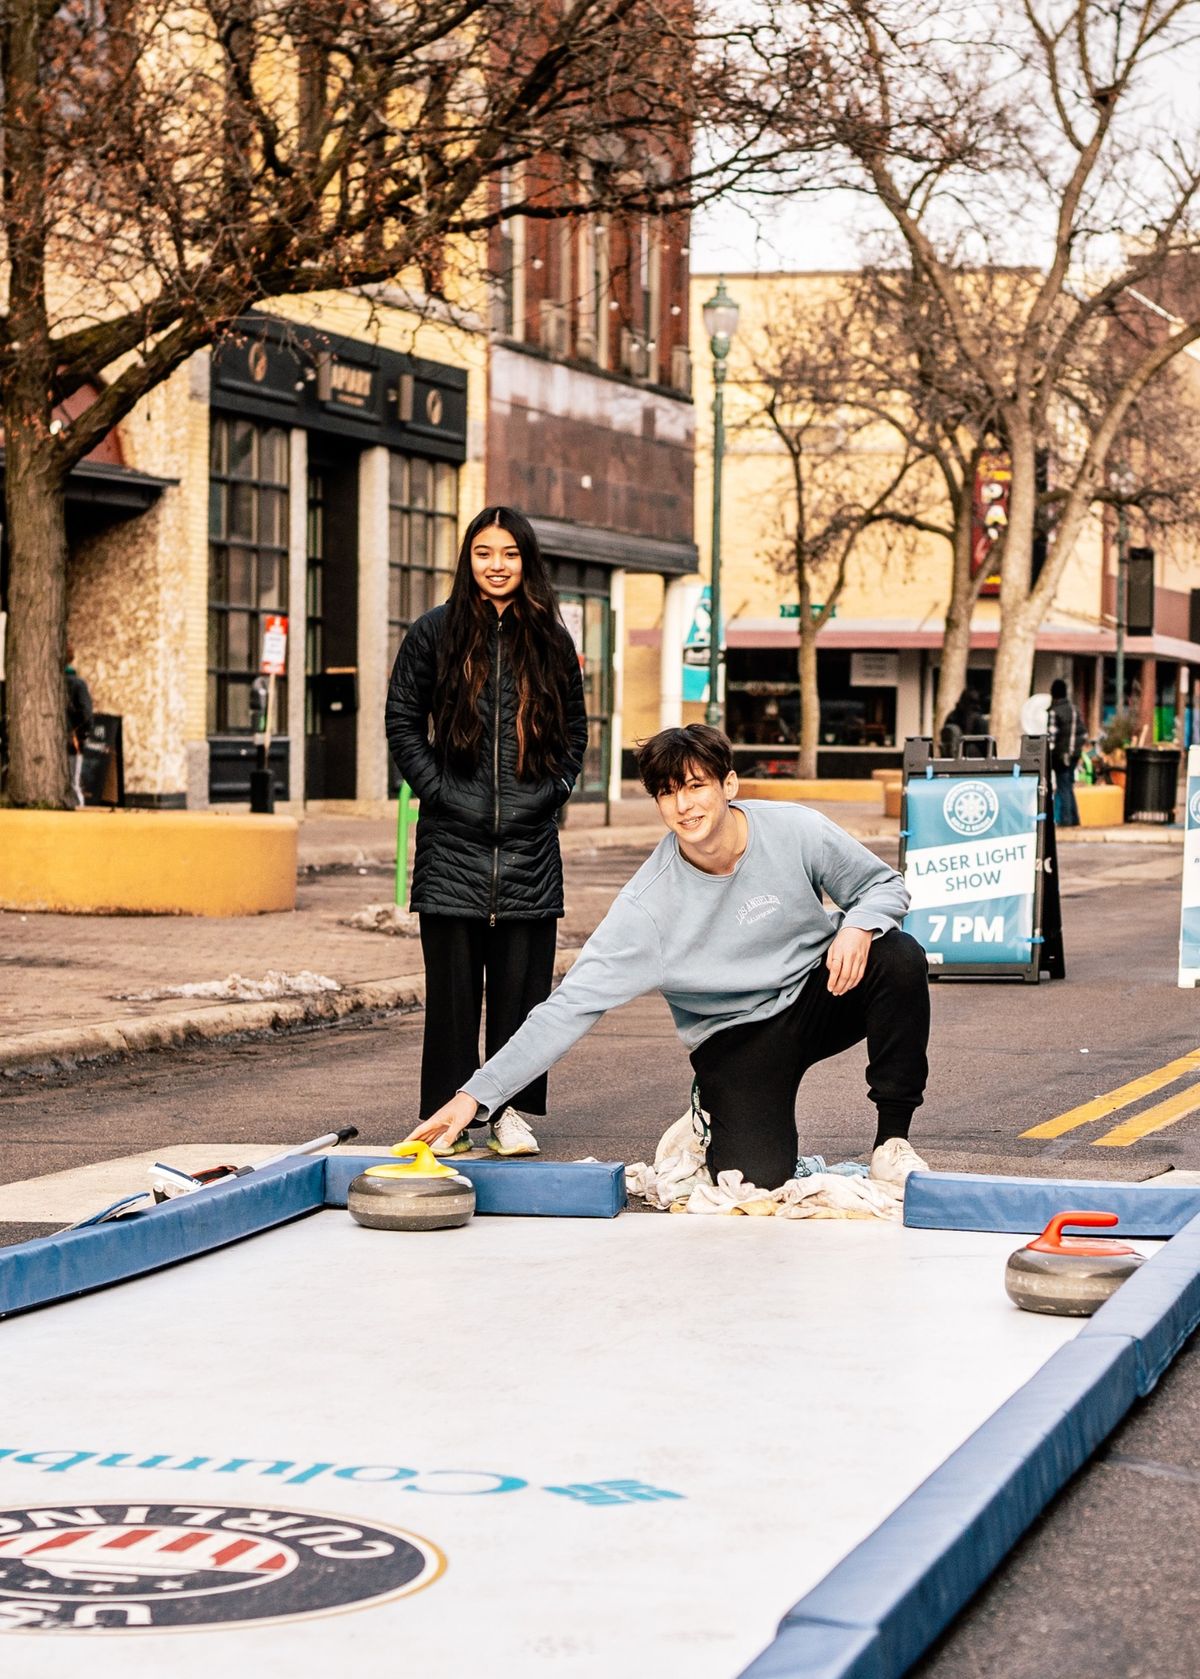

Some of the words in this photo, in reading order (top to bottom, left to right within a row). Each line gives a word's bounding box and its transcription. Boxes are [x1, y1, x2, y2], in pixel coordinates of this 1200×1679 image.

[914, 853, 971, 877] LASER
[976, 845, 1027, 868] LIGHT
[945, 870, 1001, 893] SHOW
[735, 906, 748, 926] LOS
[927, 915, 947, 943] 7
[951, 915, 1005, 943] PM
